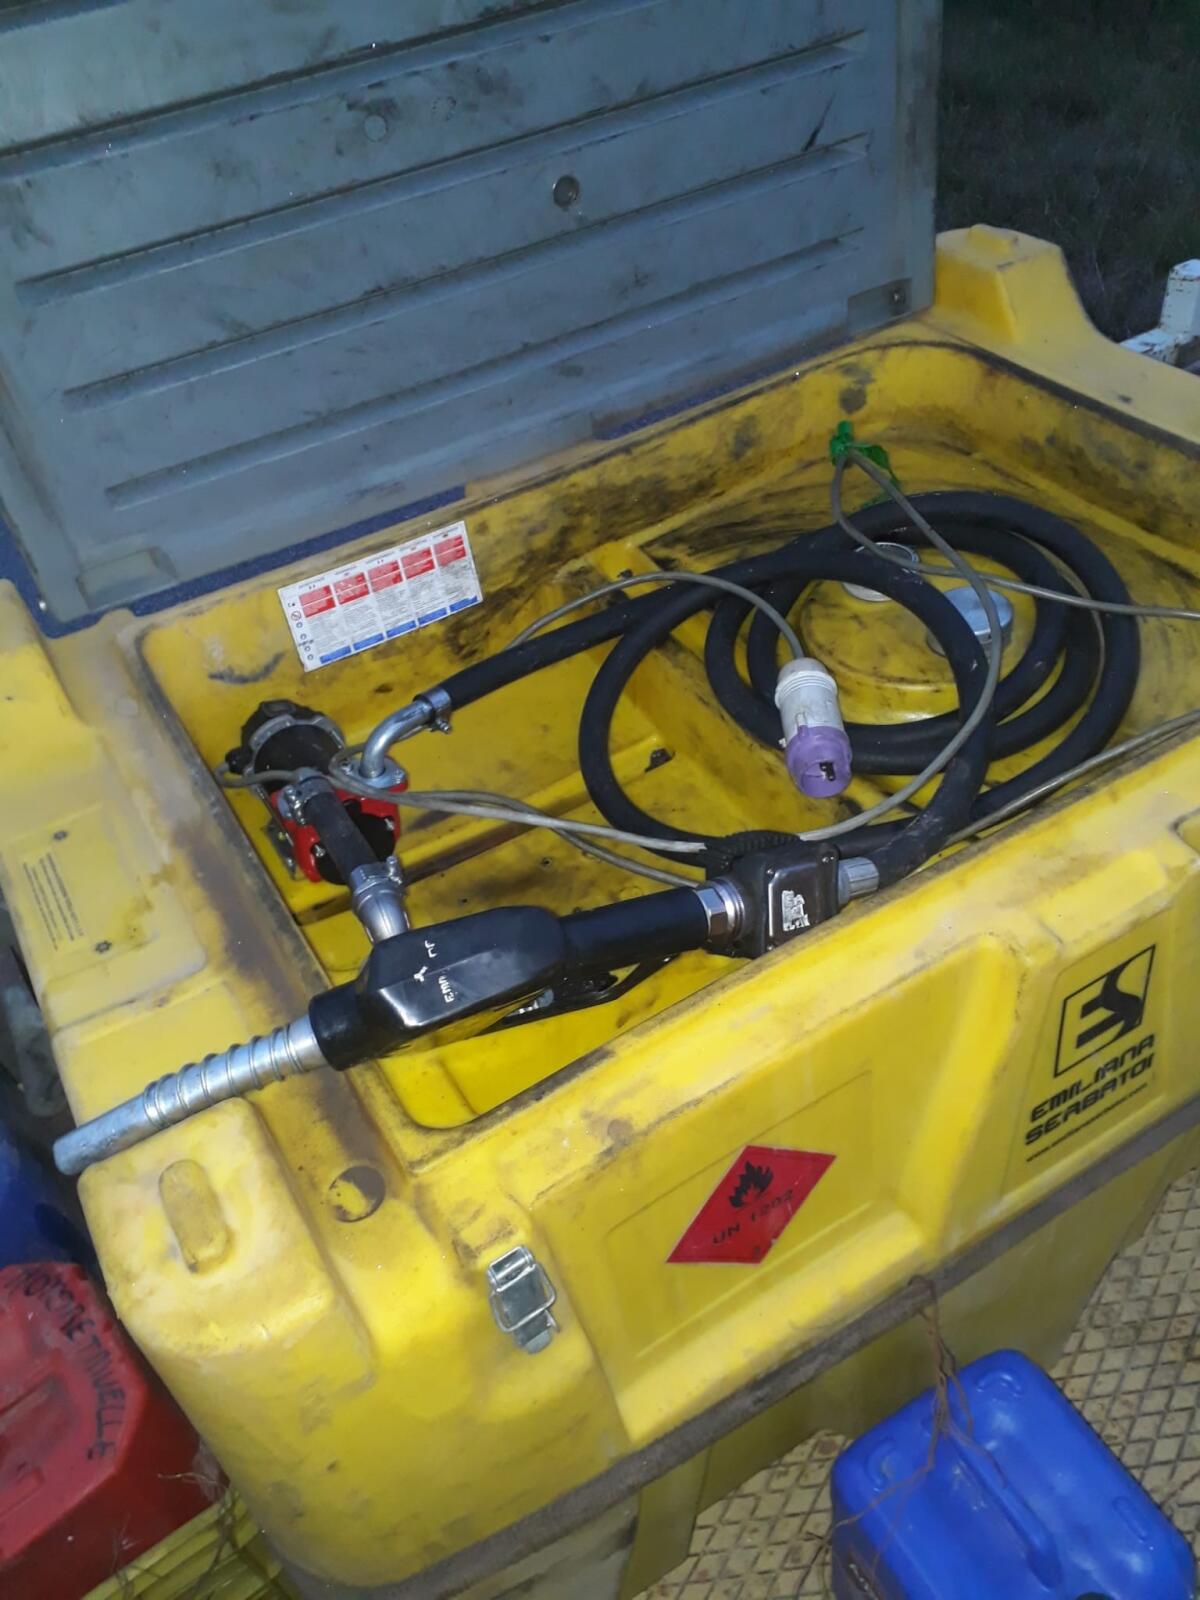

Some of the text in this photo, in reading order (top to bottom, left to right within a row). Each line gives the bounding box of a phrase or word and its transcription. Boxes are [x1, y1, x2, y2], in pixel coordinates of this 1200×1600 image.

[1024, 1052, 1155, 1146] SERBATOI
[1030, 1033, 1155, 1123] EMILIANA
[712, 1222, 741, 1244] UN
